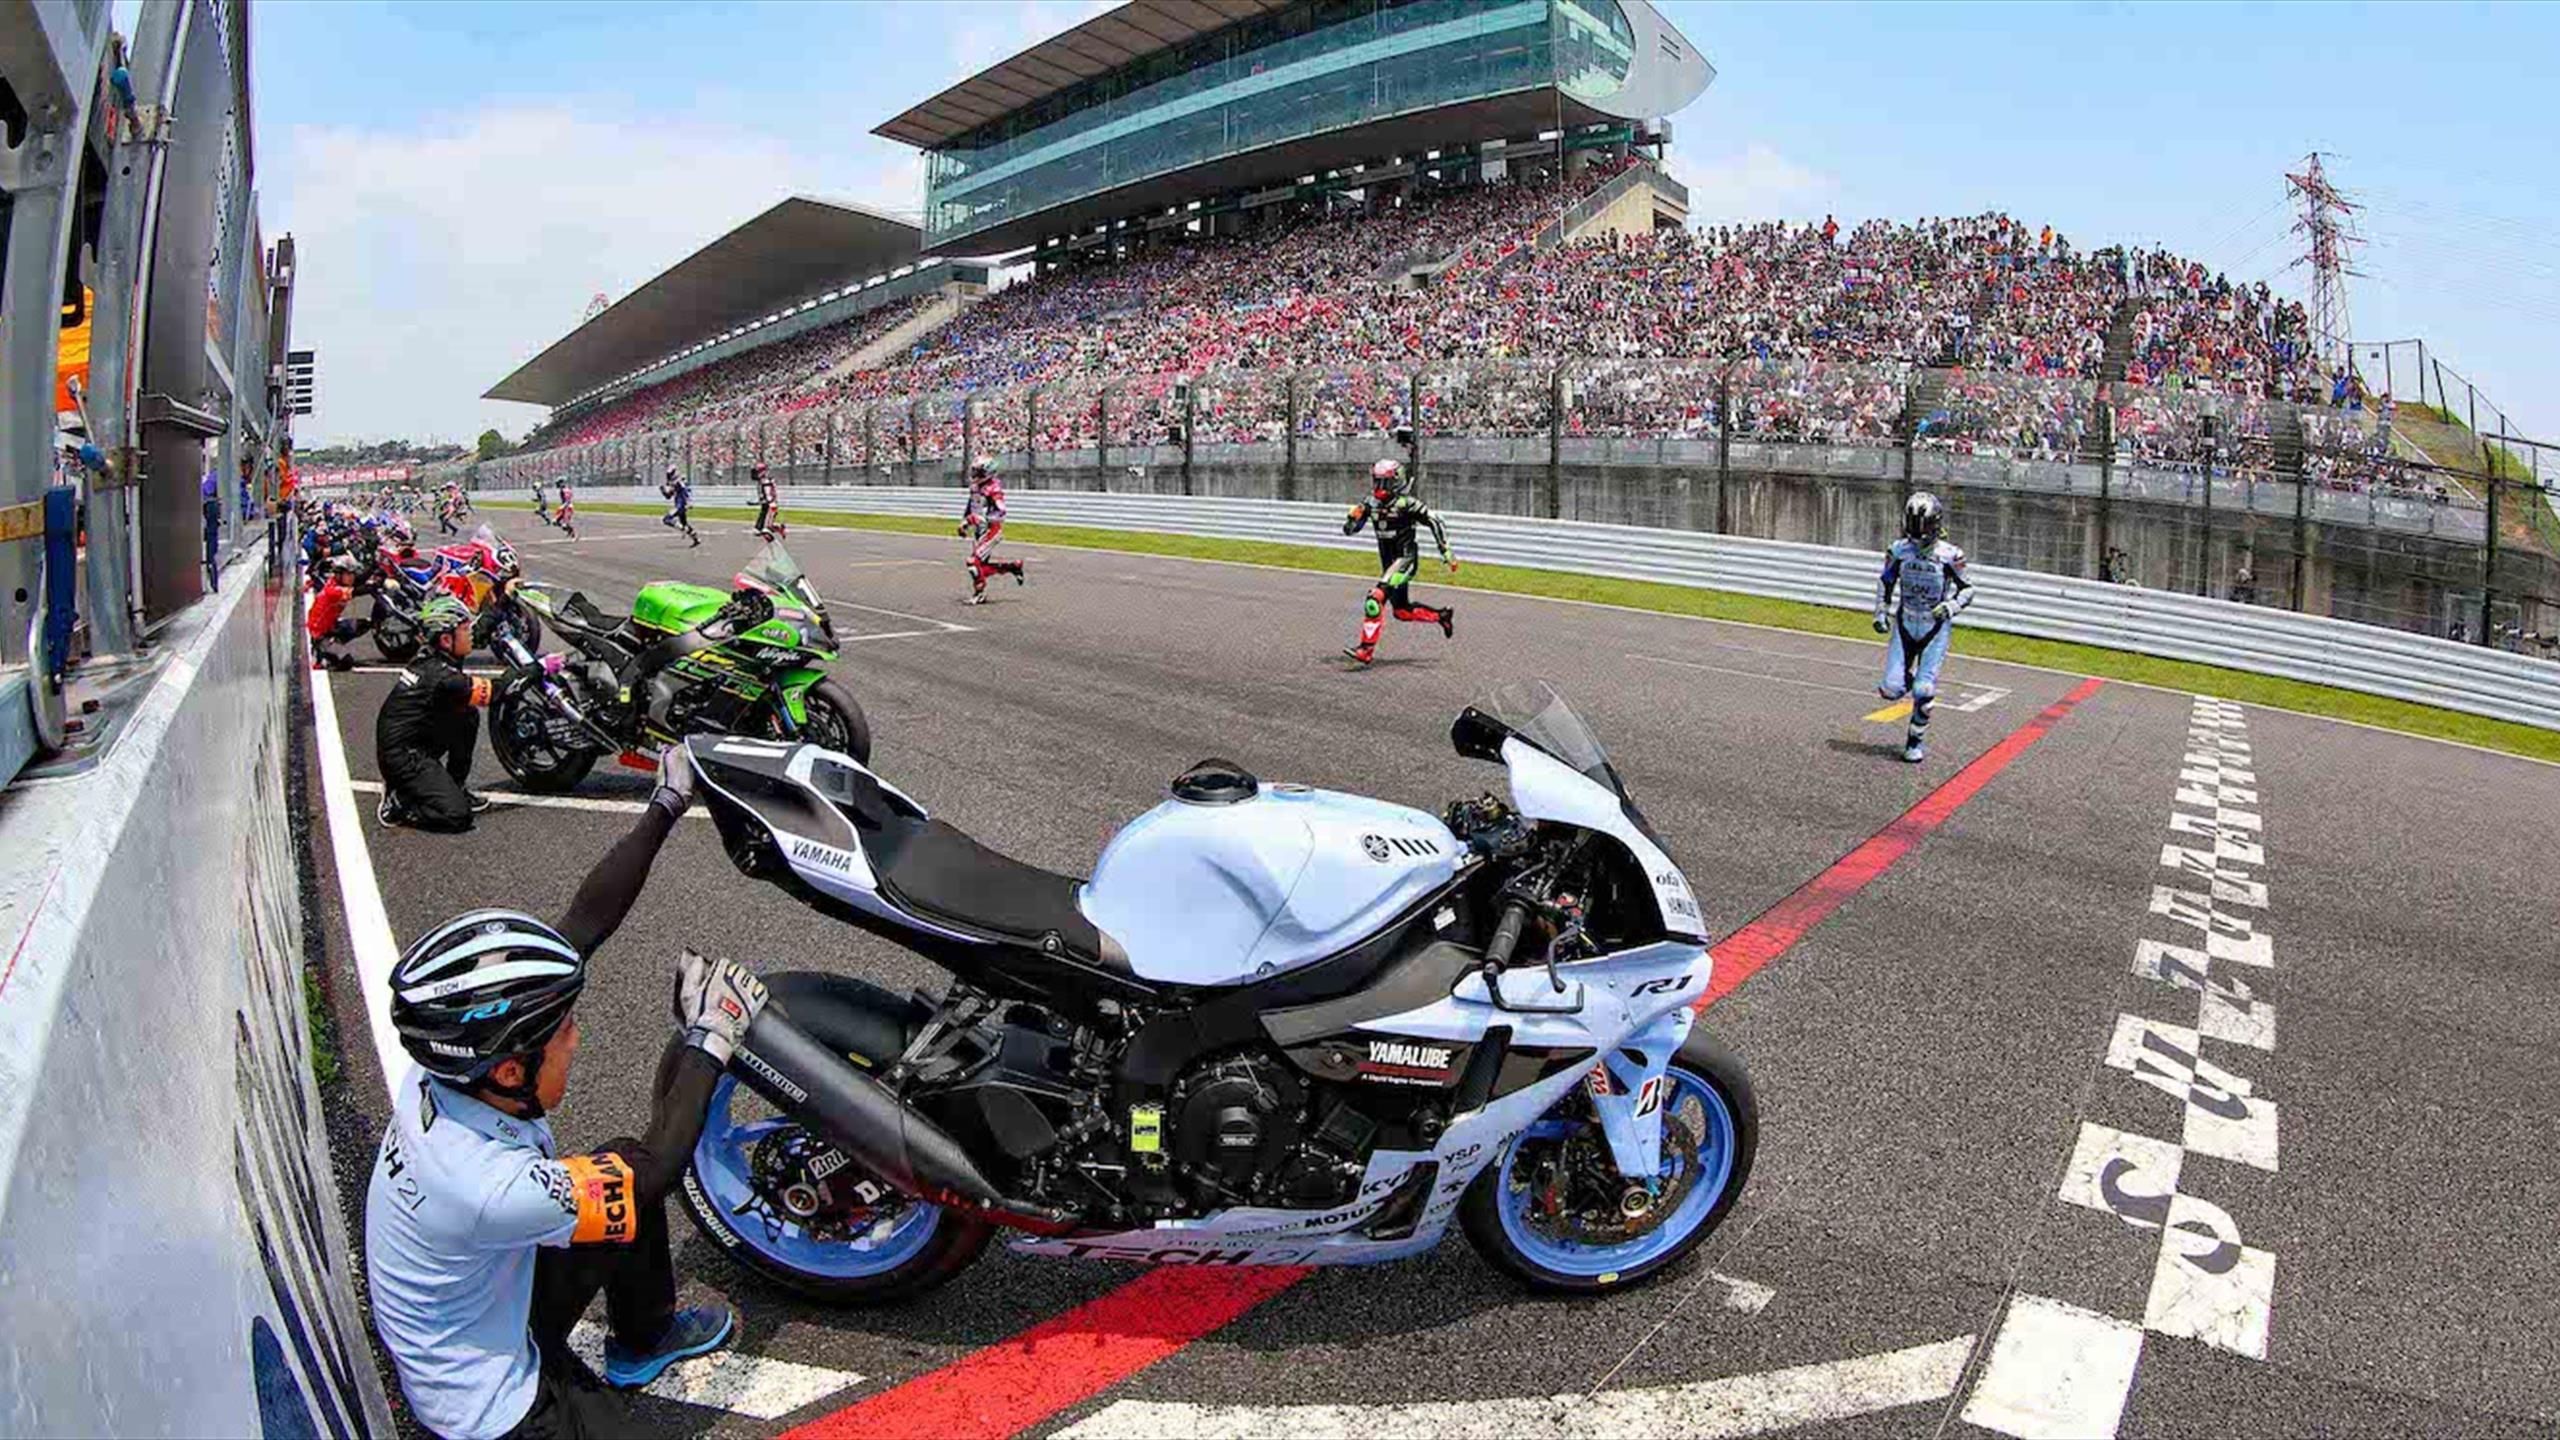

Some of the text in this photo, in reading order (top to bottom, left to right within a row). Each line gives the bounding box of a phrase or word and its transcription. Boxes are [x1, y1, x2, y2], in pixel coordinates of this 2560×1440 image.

[793, 841, 851, 873] YAMAHA
[1630, 974, 1693, 998] R1
[460, 999, 512, 1023] R1
[429, 1041, 476, 1058] YAMAHA
[1369, 1041, 1452, 1068] YAMALUBE
[1445, 1143, 1481, 1164] YSP
[1304, 1205, 1376, 1228] MOTUL
